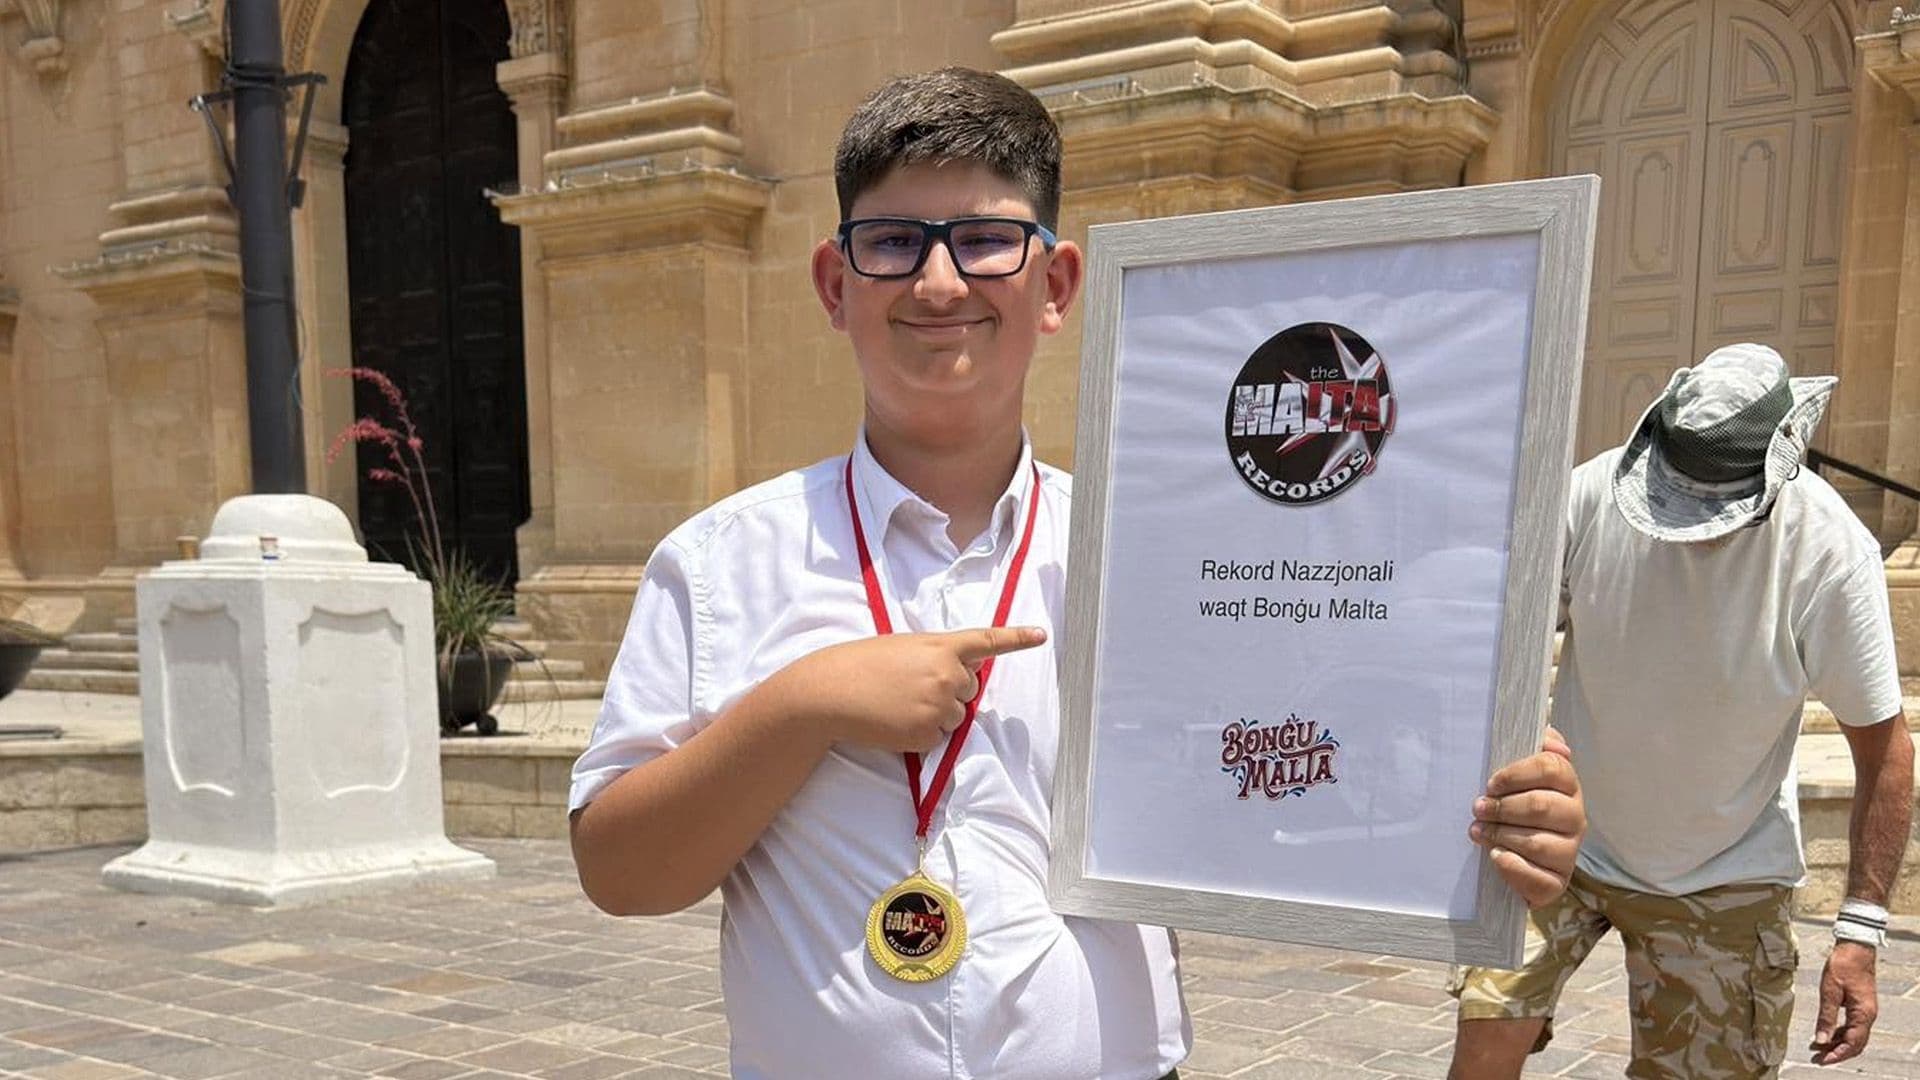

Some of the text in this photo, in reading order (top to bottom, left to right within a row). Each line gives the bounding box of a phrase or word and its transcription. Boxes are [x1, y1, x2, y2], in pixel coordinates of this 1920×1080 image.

[1310, 366, 1339, 379] the
[1232, 379, 1381, 436] MALTA
[1237, 450, 1368, 499] RECORDS
[1201, 560, 1394, 586] Rekord Nazzjonali
[1200, 597, 1388, 623] waqt Bonġu Malta
[1238, 744, 1334, 798] MALTA
